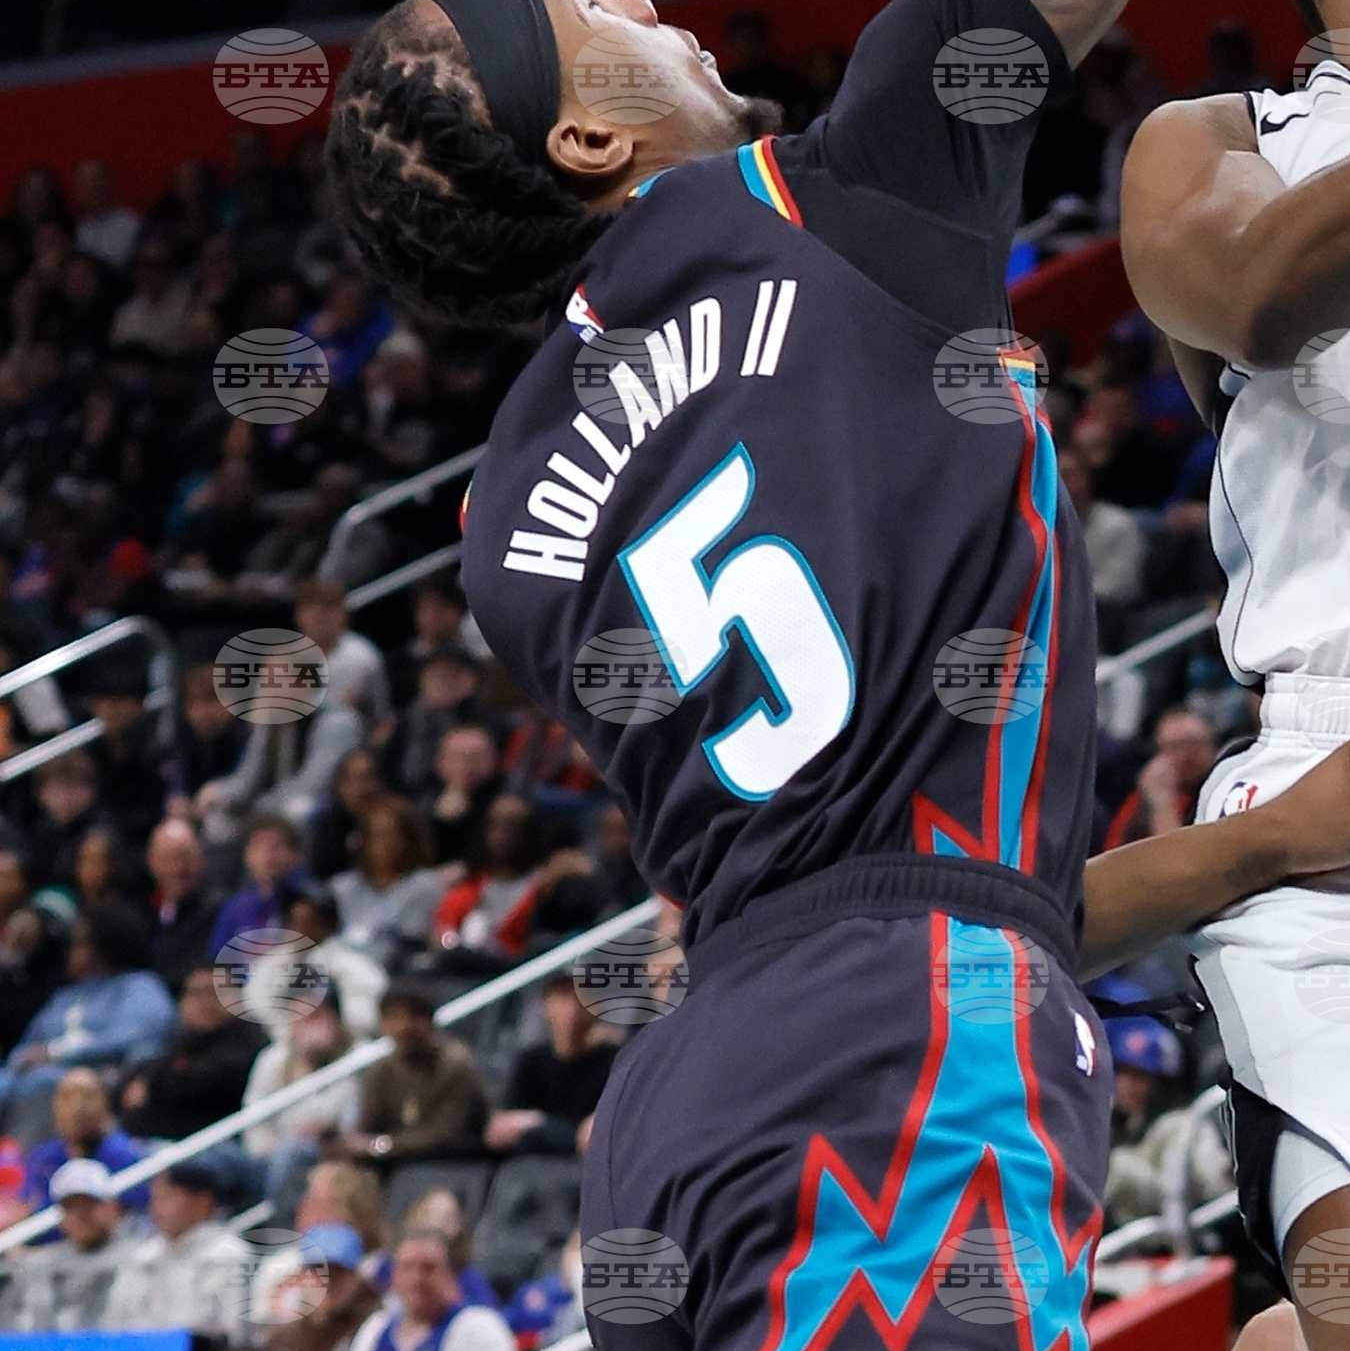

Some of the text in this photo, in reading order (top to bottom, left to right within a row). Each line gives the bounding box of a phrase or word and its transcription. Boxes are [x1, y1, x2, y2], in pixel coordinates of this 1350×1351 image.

[502, 279, 797, 582] HOLLAND II
[616, 441, 856, 802] 5
